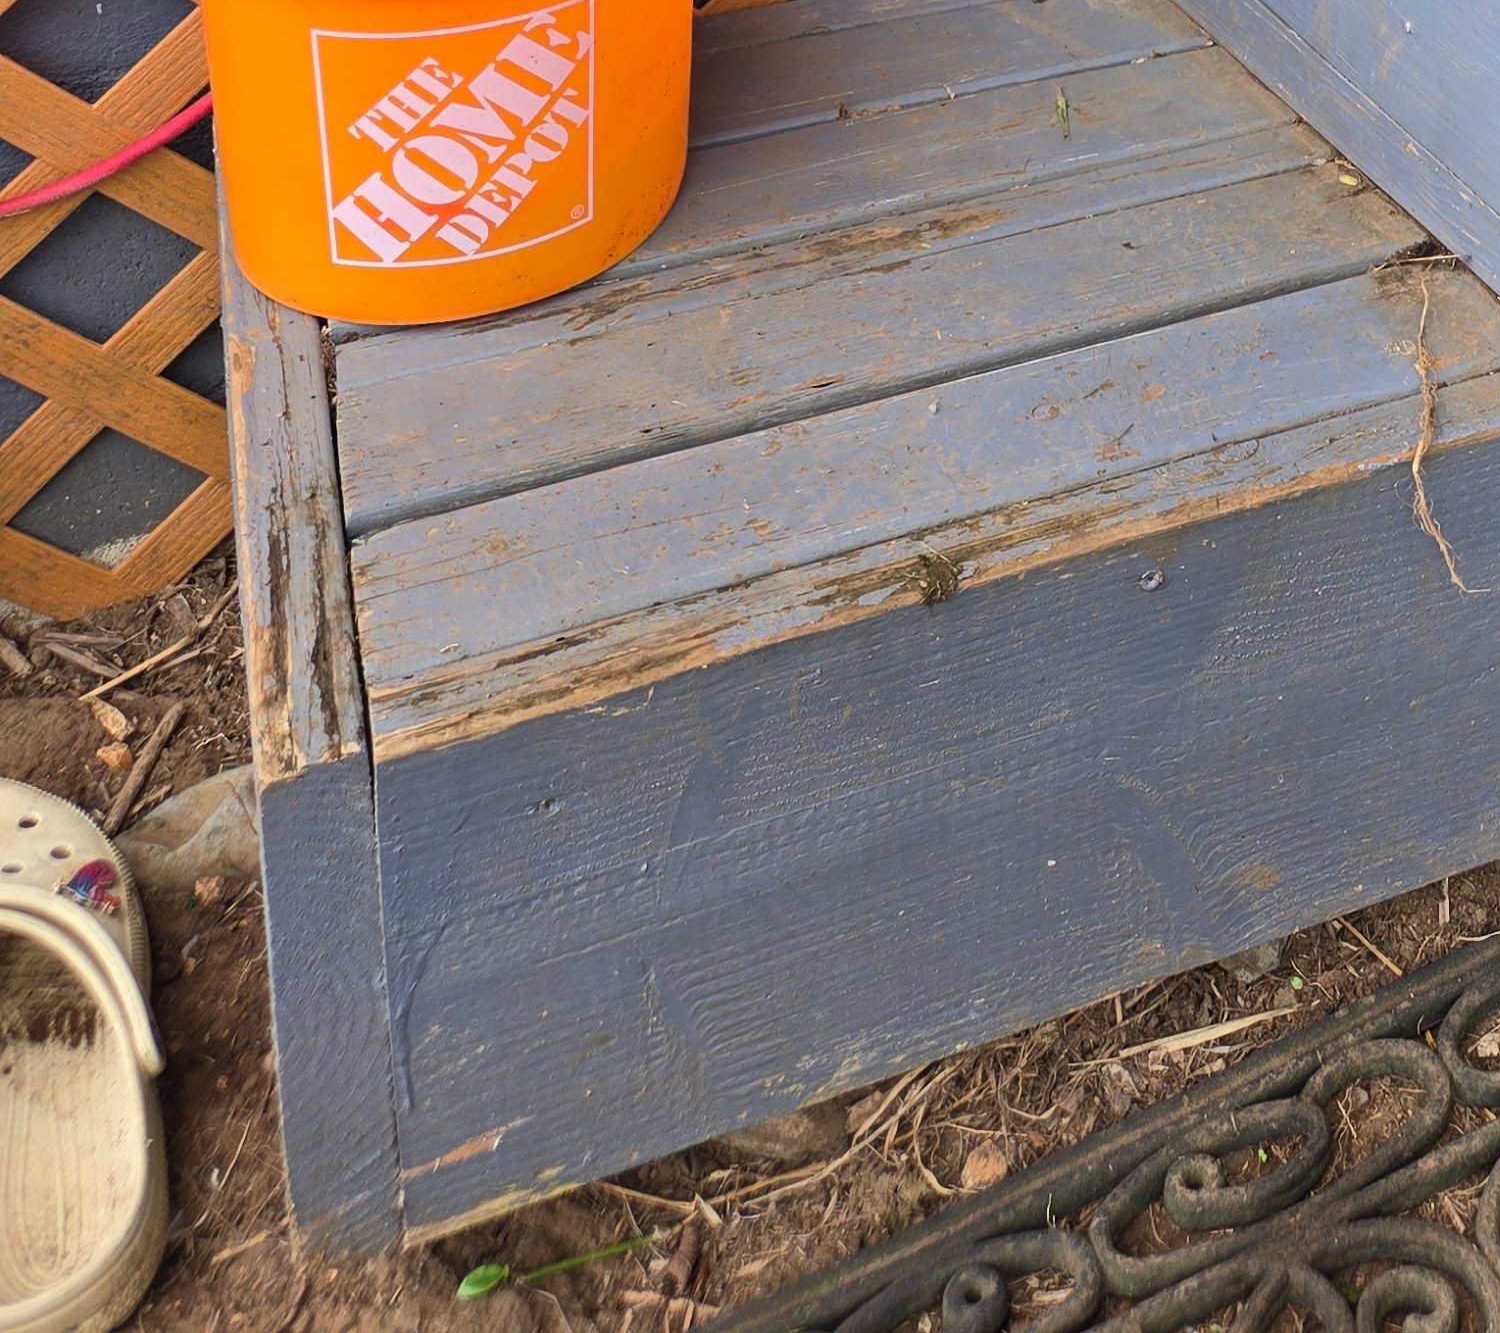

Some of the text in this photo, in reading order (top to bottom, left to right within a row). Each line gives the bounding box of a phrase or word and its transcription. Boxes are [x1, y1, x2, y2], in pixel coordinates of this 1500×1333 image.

[332, 11, 592, 264] HOME
[347, 56, 464, 153] THE
[434, 87, 590, 257] DEPOT
